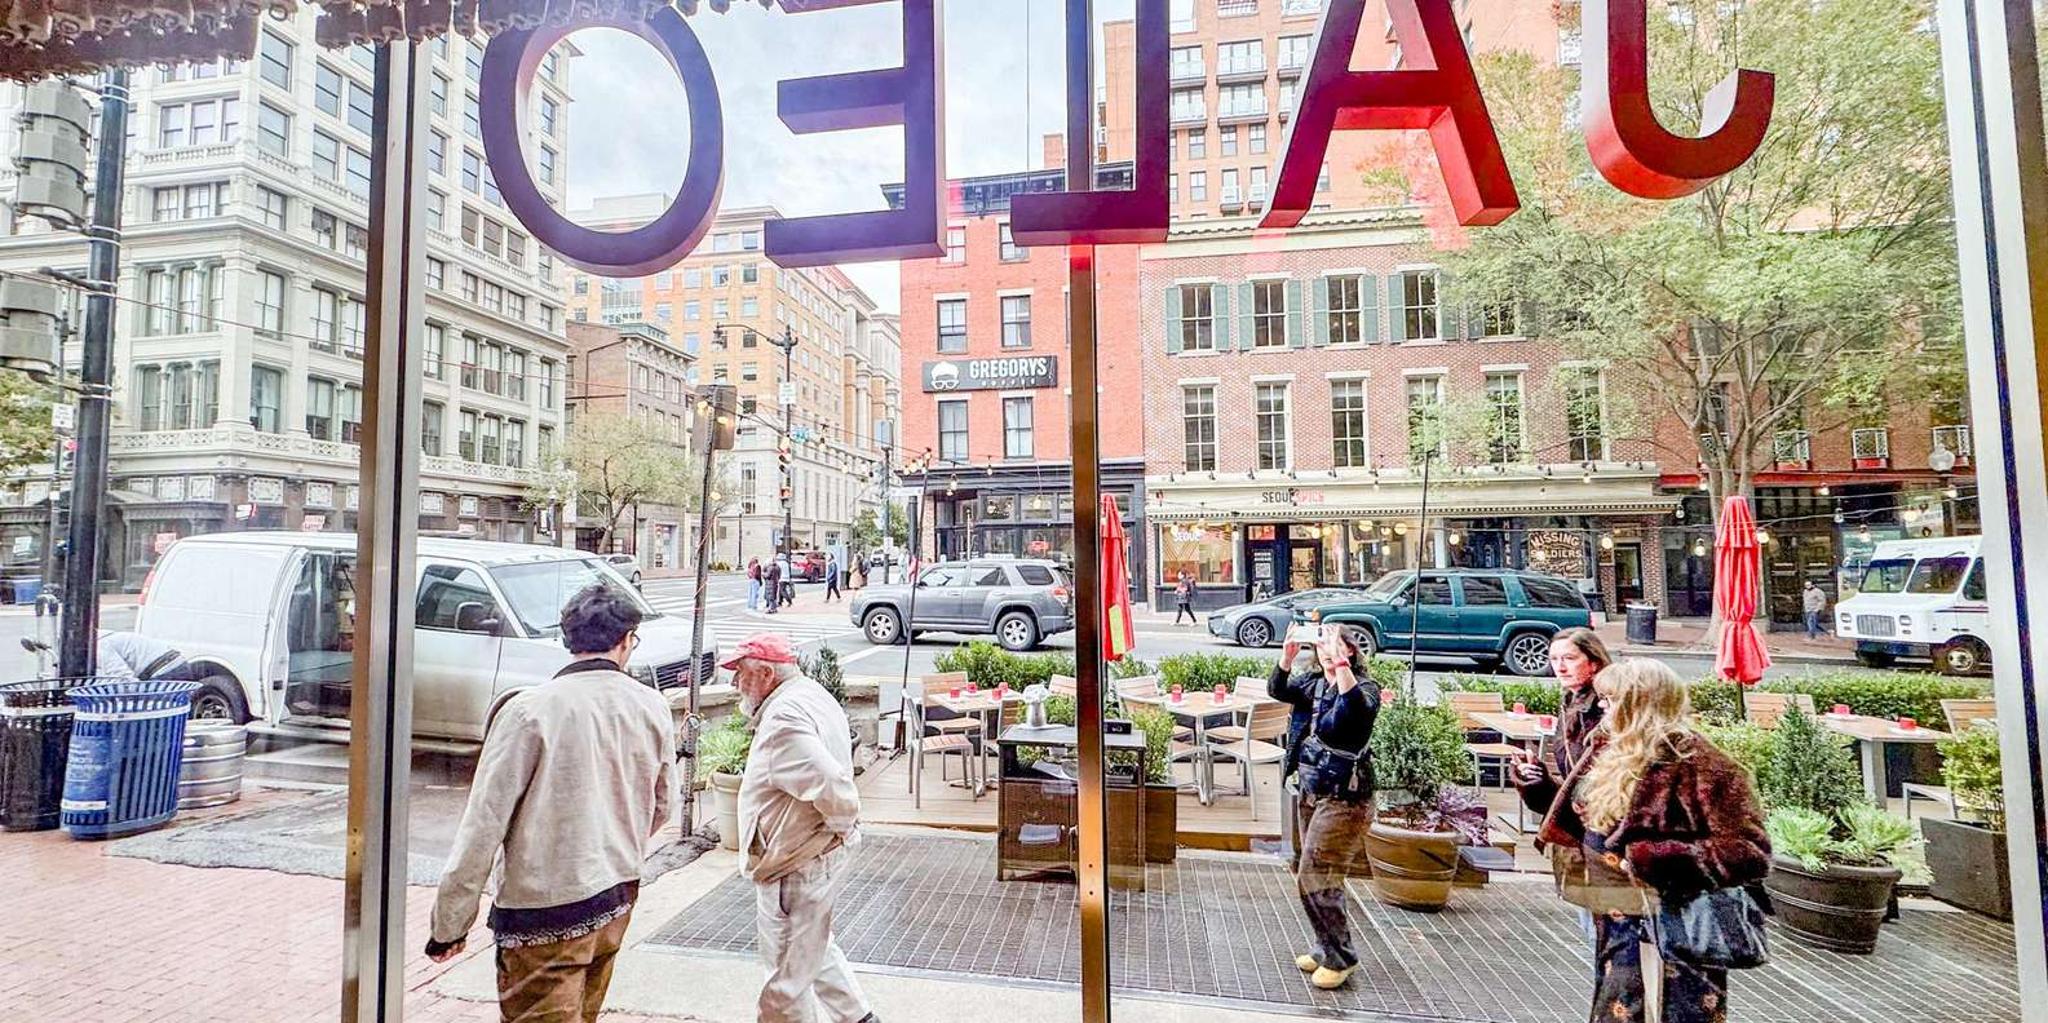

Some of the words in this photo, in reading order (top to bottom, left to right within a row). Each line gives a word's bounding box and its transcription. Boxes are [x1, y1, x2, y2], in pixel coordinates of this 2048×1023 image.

[969, 357, 1047, 379] GREGORYS
[1530, 531, 1580, 548] MISSING
[1530, 549, 1582, 558] SLDIERS
